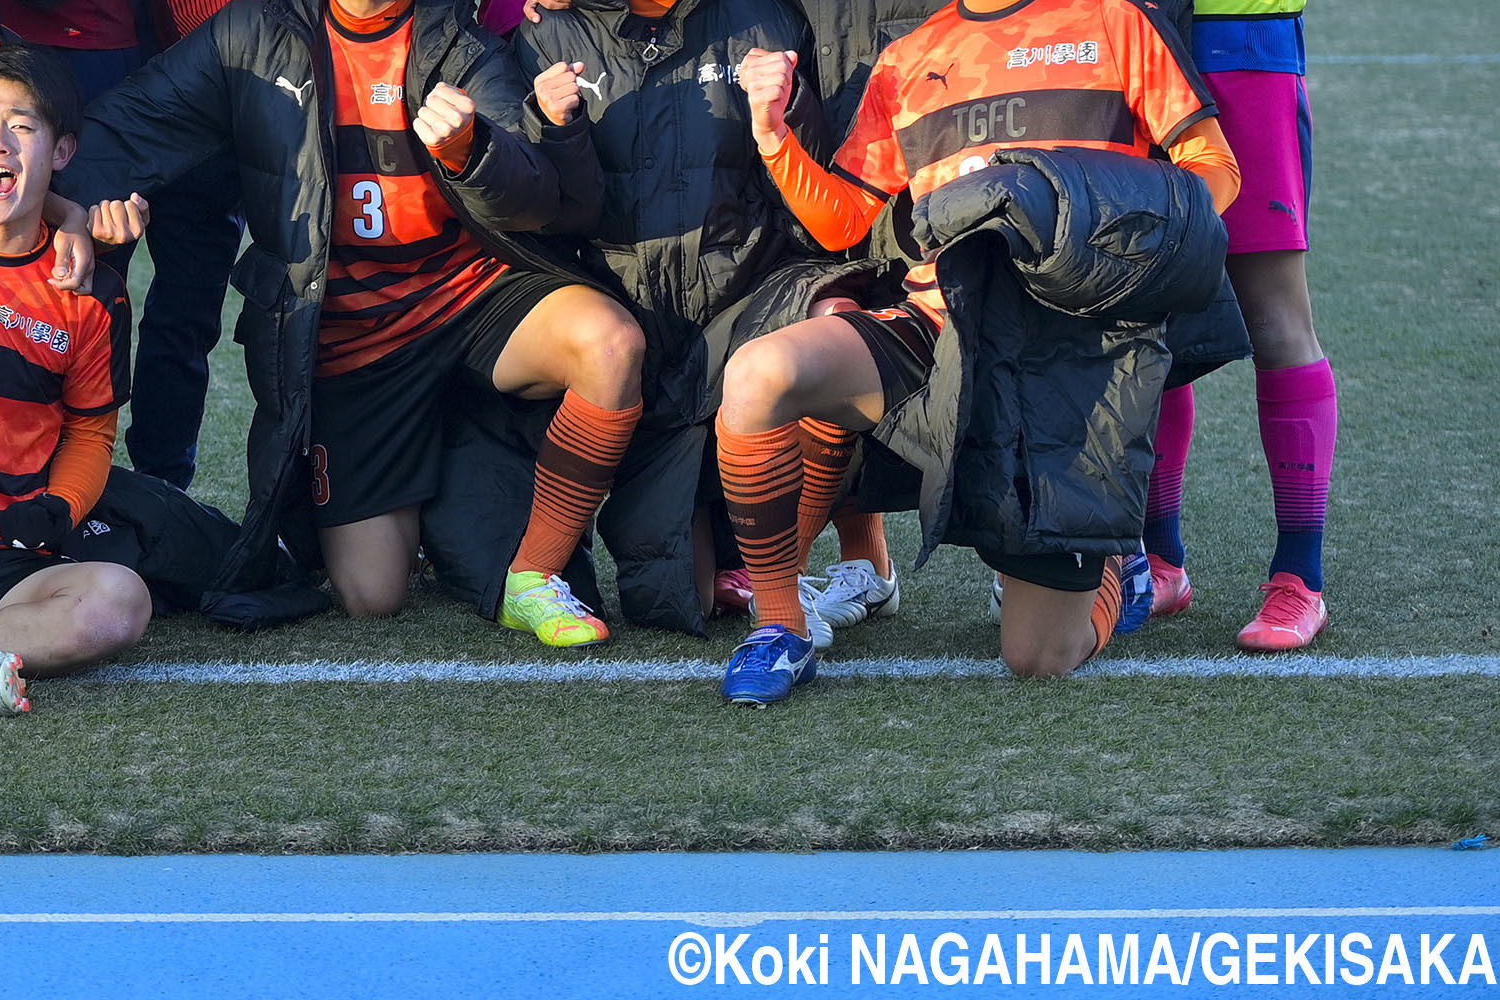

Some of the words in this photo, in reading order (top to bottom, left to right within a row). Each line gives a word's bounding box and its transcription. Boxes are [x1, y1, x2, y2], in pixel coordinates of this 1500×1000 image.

[952, 96, 1027, 143] TGFC
[351, 179, 385, 239] 3
[310, 443, 331, 506] 3
